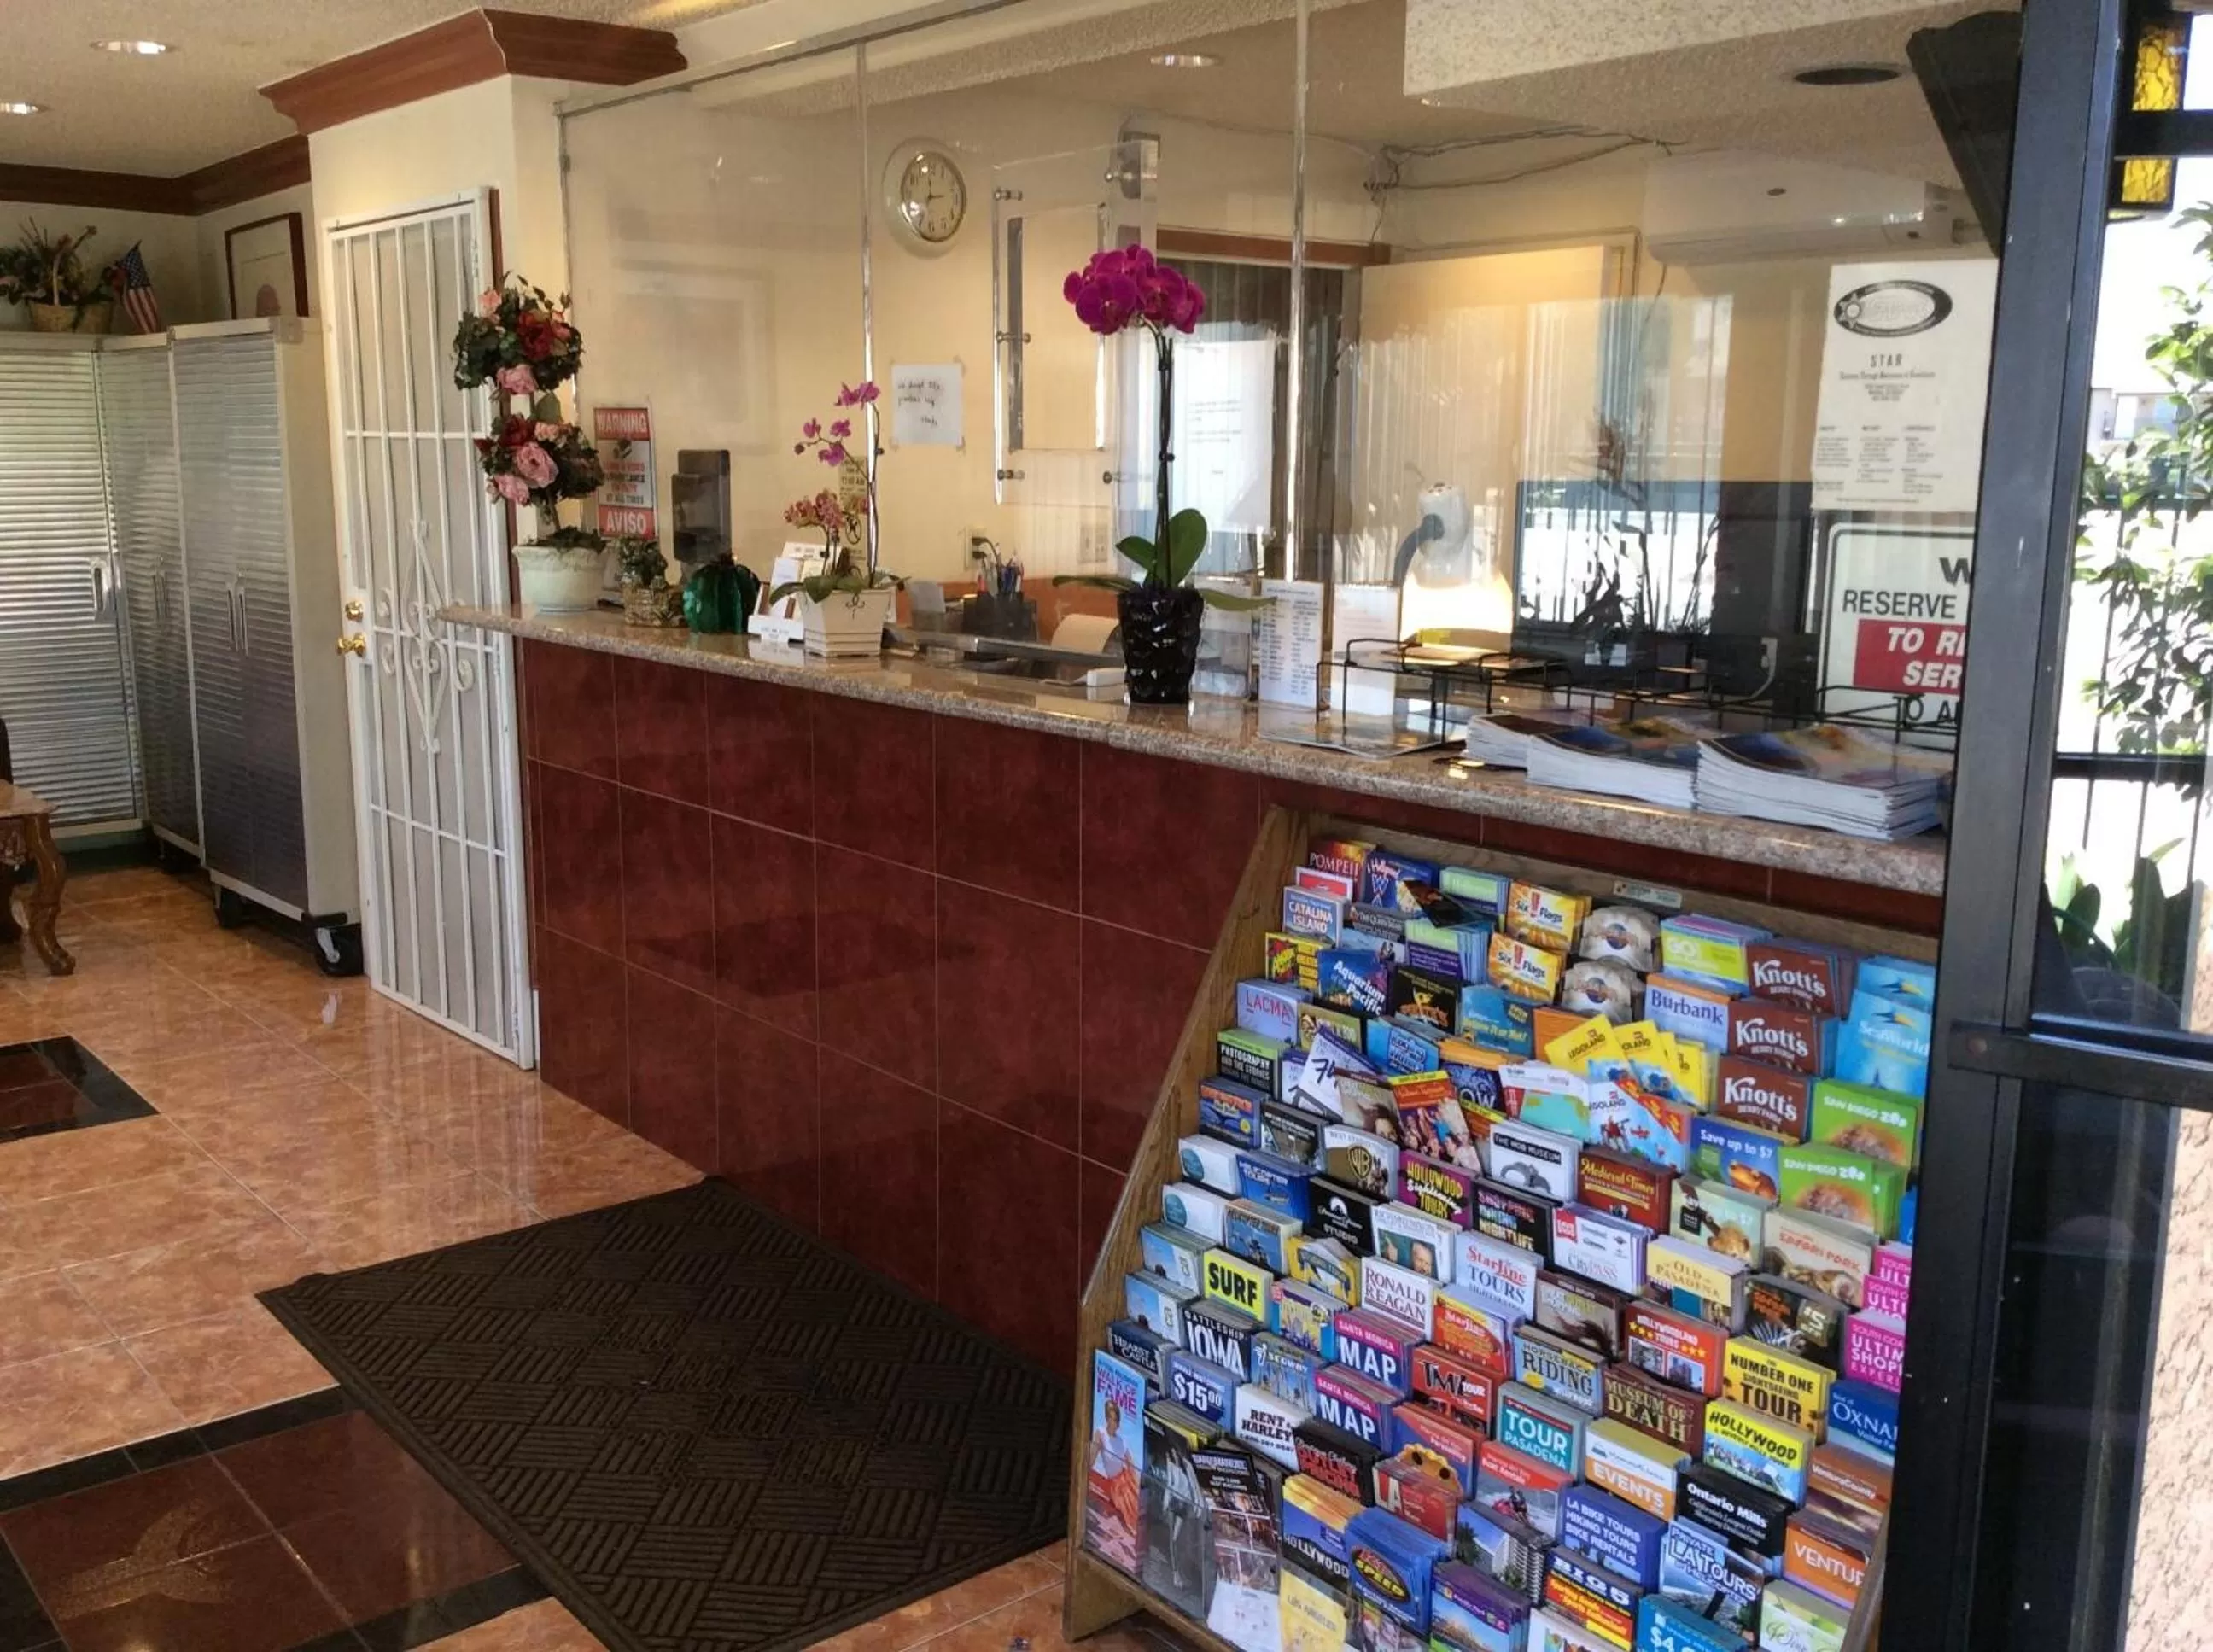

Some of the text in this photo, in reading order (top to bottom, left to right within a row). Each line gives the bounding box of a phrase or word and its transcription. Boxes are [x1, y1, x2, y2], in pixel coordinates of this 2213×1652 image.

[597, 413, 647, 433] WARNING
[606, 511, 647, 534] AVISO
[1842, 589, 1957, 619] RESERVE
[1888, 627, 1924, 653] TO
[1288, 901, 1334, 923] CATALINA
[1293, 915, 1328, 933] ISLAND
[1539, 907, 1563, 924] Flags
[1333, 960, 1386, 1004] Aquarium
[1498, 952, 1546, 978] Six Flags
[1753, 960, 1826, 997] Knott's
[1246, 990, 1291, 1019] LACMA
[1346, 982, 1382, 1016] Pacific
[1651, 989, 1725, 1025] Burbank
[1568, 1033, 1605, 1059] LEGOLAND
[1735, 1018, 1809, 1058] Knott's
[1725, 1077, 1797, 1122] Knott's
[1528, 1144, 1562, 1164] MUSEUM
[1700, 1130, 1772, 1159] Save up to $7
[1407, 1161, 1463, 1199] HOLLYWOOD
[1323, 1223, 1358, 1245] STUDIO
[1467, 1244, 1527, 1287] Starline
[1657, 1263, 1720, 1299] PASADENA
[1673, 1260, 1702, 1279] OLD
[1208, 1262, 1257, 1307] SURF
[1366, 1268, 1426, 1305] RONALD
[1366, 1284, 1426, 1321] REAGAN
[1469, 1266, 1525, 1305] TOURS
[1184, 1311, 1245, 1338] BATTLESHIP
[1340, 1320, 1394, 1351] SANTA MONICA
[1113, 1335, 1151, 1357] HEARST
[1187, 1321, 1245, 1381] IOWA
[1268, 1351, 1308, 1373] SEGWAY
[1340, 1336, 1397, 1386] MAP
[1523, 1348, 1593, 1397] RIDING
[1731, 1353, 1814, 1393] NUMBER ONE
[1318, 1378, 1372, 1412] SANTA MONICA
[1607, 1378, 1686, 1421] MUSEUM OF
[1740, 1381, 1801, 1424] TOUR
[1241, 1419, 1293, 1443] HARLEY
[1250, 1409, 1285, 1427] RENT
[1320, 1395, 1375, 1442] MAP
[1506, 1409, 1568, 1456] TOUR
[1608, 1392, 1686, 1442] DEATH
[1709, 1410, 1797, 1461] HOLLYWOOD
[1833, 1402, 1899, 1440] OXNA
[1505, 1430, 1566, 1469] PASADENA
[1594, 1461, 1664, 1509] EVENTS
[1567, 1497, 1640, 1543] LA BIKE TOURS
[1687, 1483, 1767, 1528] Ontario Mills
[1566, 1511, 1638, 1554] HIKING TOURS
[1566, 1523, 1637, 1567] BIKE RENTALS
[1671, 1527, 1715, 1556] PRIVATE
[1285, 1533, 1350, 1578] HOLLYWOOD
[1355, 1557, 1405, 1601] SPEED
[1698, 1551, 1757, 1602] TOURS
[1610, 1585, 1630, 1606] 5
